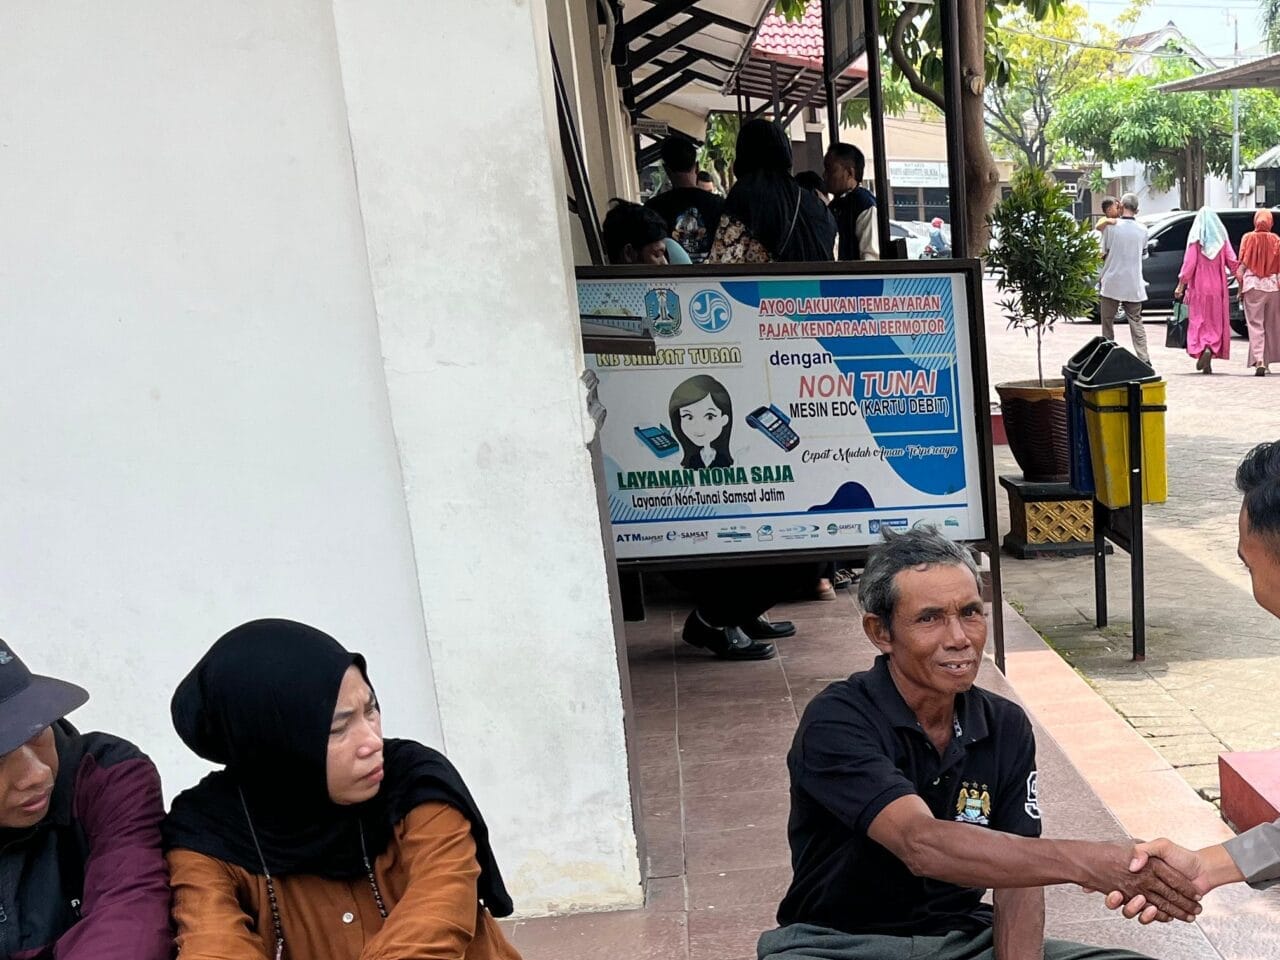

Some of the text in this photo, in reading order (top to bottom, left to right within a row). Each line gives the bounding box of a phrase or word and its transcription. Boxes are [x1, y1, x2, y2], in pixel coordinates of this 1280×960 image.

[759, 296, 940, 315] AYOO LAKUKAN PEMBAYARAN
[759, 318, 945, 338] PAJAK KENDARAAN BERMOTOR
[688, 347, 742, 364] TUBAN
[769, 350, 833, 368] dengan
[799, 370, 937, 398] NON TUNAI
[789, 396, 950, 418] MESIN EDC (KARTU DEBIT)
[801, 448, 833, 463] Cepat
[833, 446, 872, 463] Mudah
[873, 446, 904, 461] Aman
[617, 465, 794, 490] LAYANAN NONA SAJA
[631, 488, 785, 510] Layanan Non-Tunai Samsat Jatim
[616, 533, 642, 543] ATM
